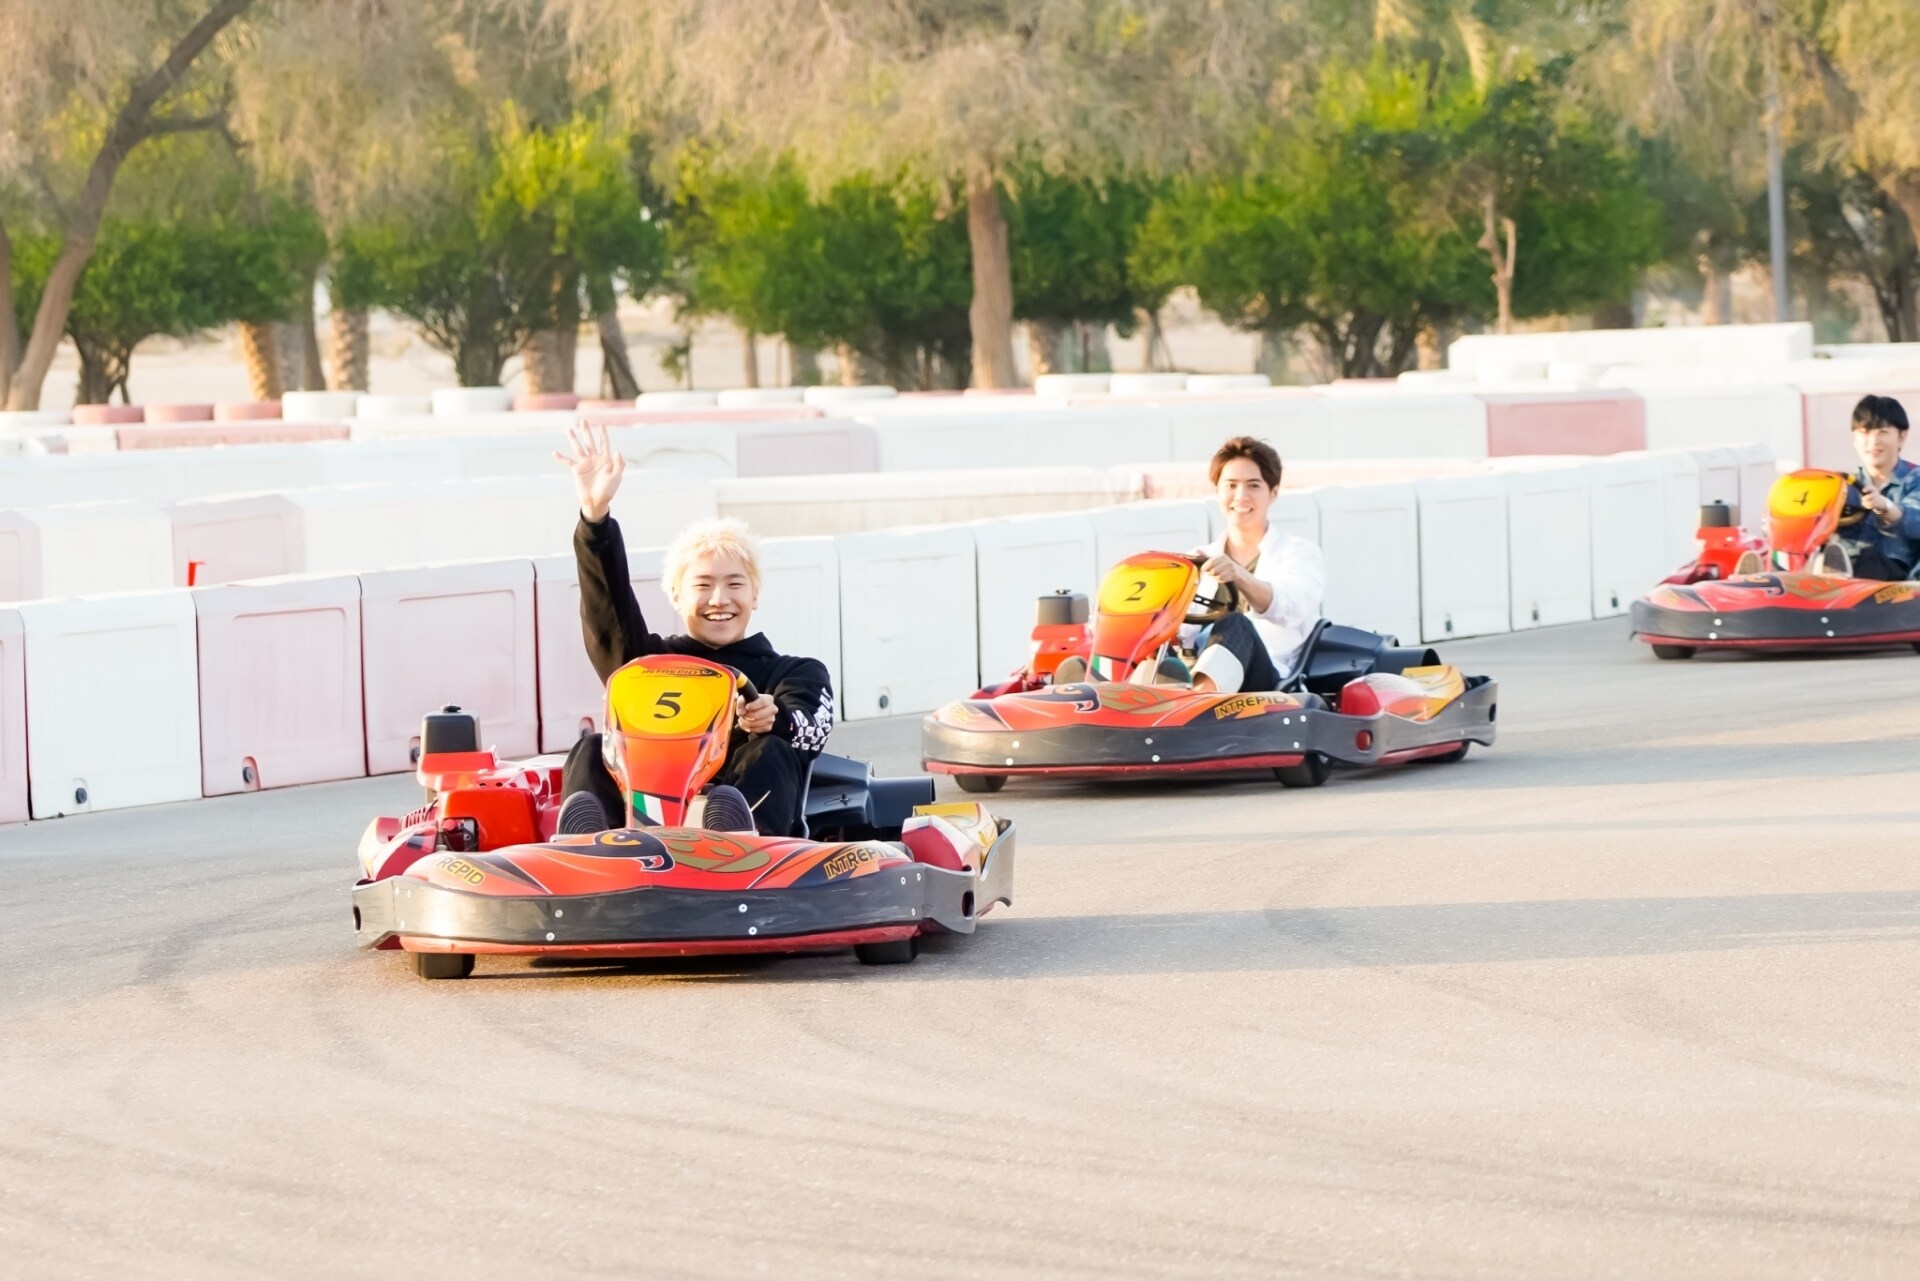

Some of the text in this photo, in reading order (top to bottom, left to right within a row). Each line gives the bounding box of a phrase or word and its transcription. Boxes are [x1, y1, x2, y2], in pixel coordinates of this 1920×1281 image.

[1793, 490, 1809, 506] 4
[1123, 581, 1147, 602] 2
[653, 691, 683, 719] 5
[1215, 695, 1289, 717] INTREPID
